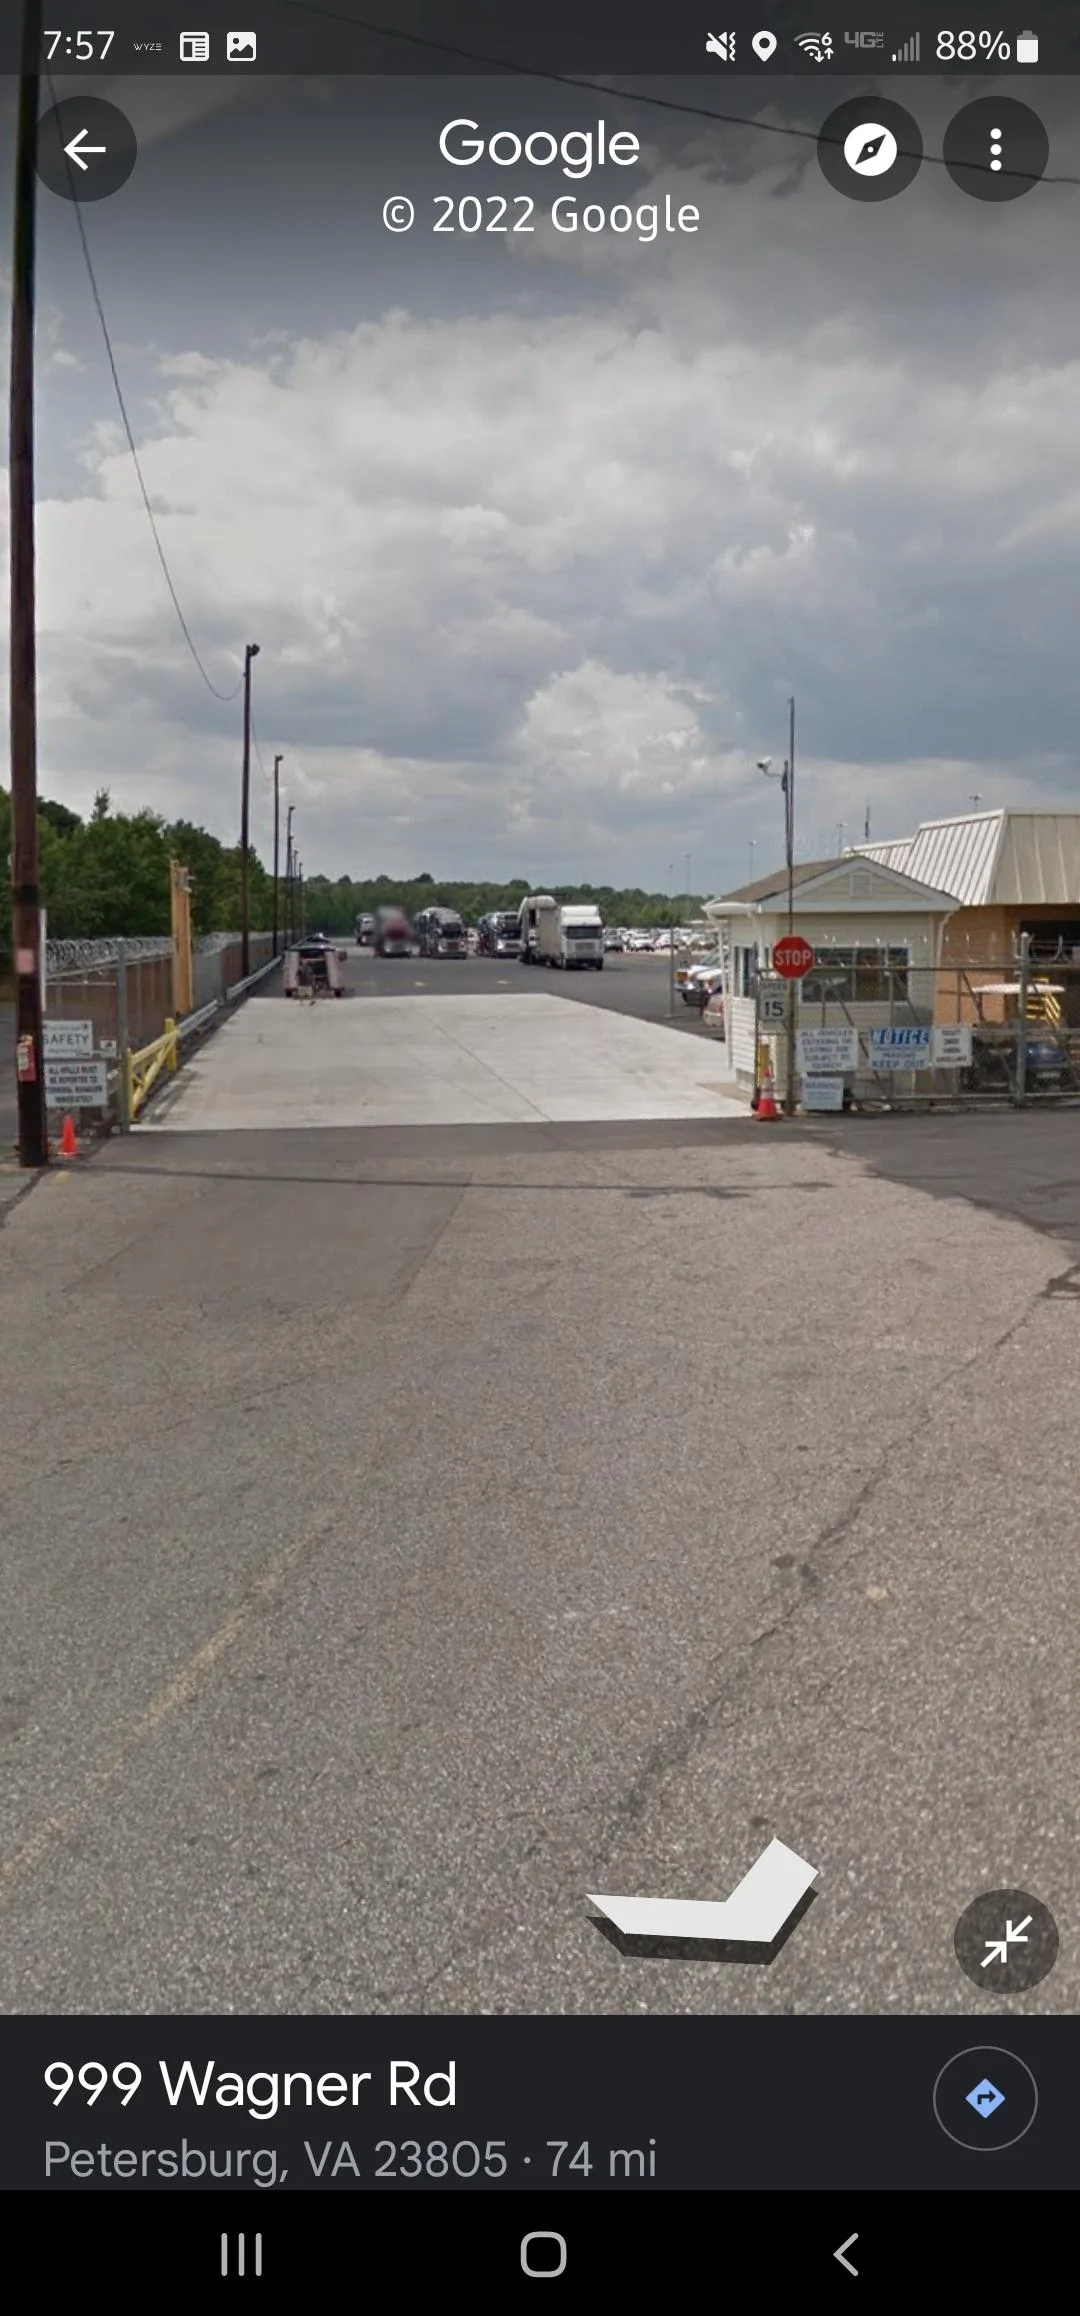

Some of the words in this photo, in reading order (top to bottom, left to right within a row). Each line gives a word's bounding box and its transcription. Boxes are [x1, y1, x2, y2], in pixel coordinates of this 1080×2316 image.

[774, 950, 812, 966] STOP
[765, 1001, 784, 1017] 15
[43, 1033, 89, 1046] SAFETY
[871, 1060, 900, 1068] KEEP
[903, 1060, 925, 1069] OUT
